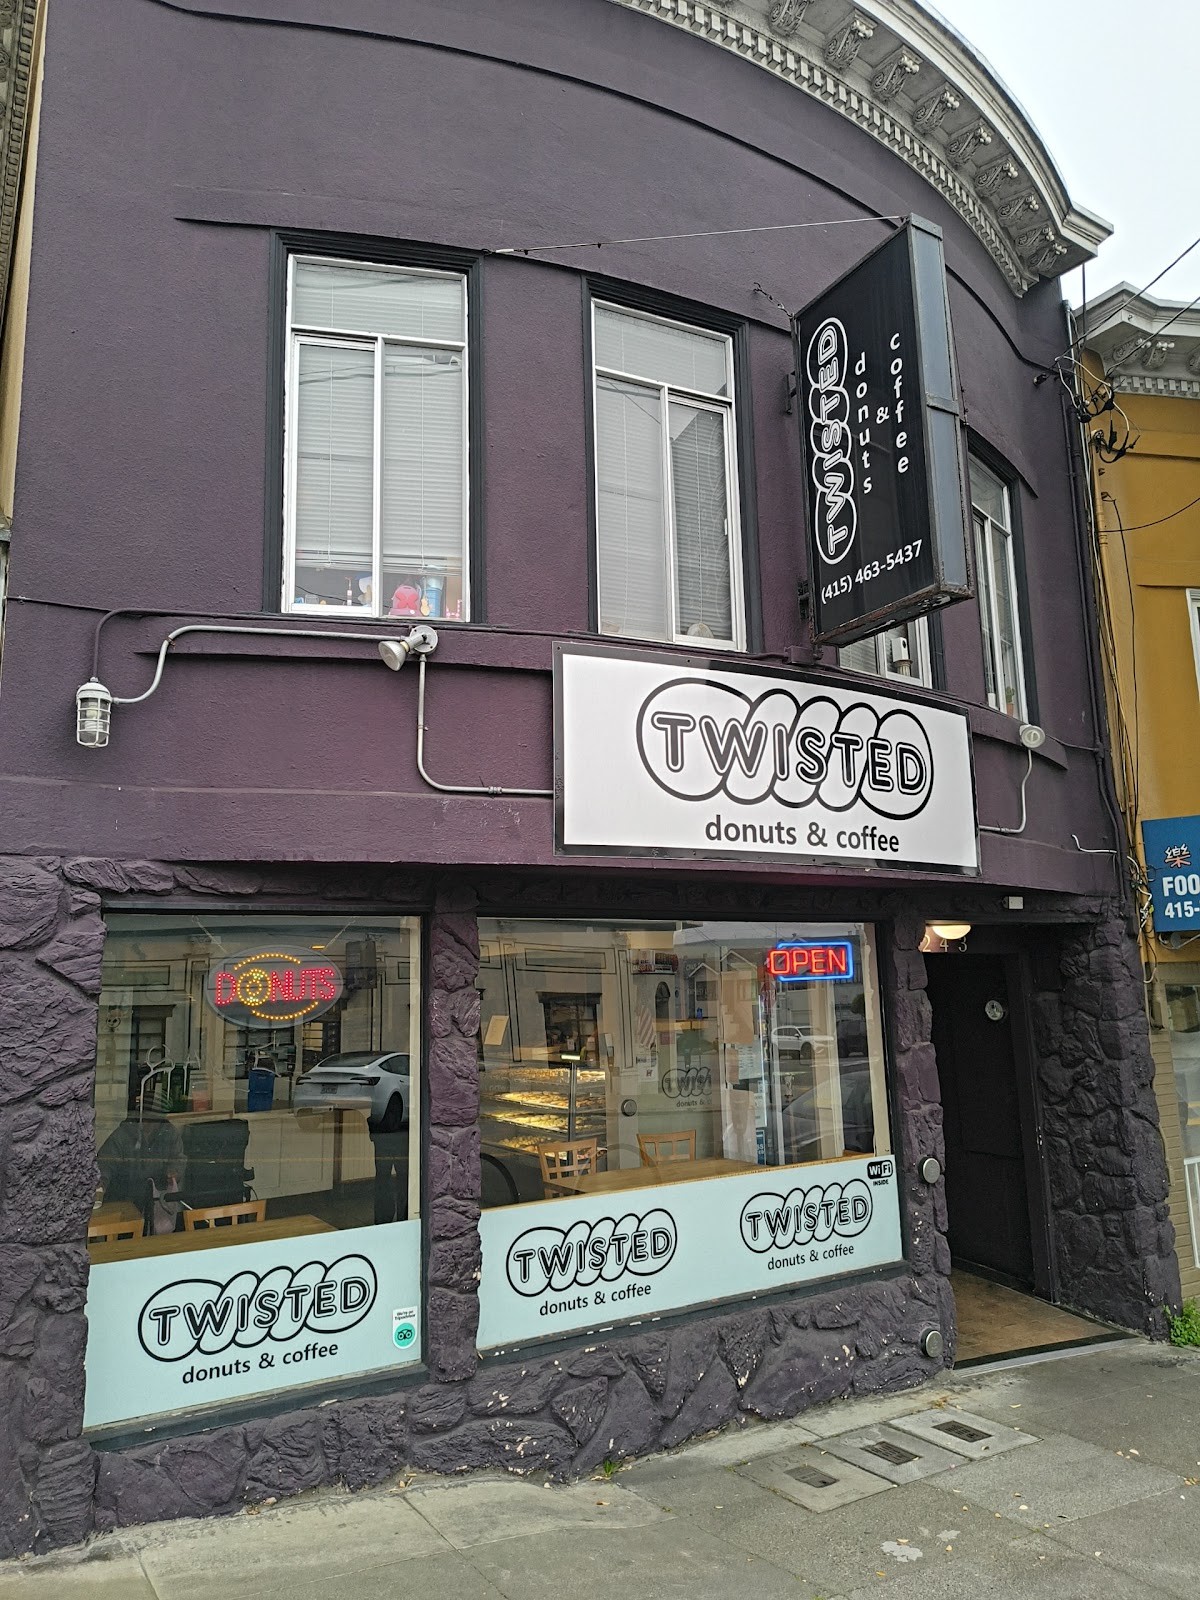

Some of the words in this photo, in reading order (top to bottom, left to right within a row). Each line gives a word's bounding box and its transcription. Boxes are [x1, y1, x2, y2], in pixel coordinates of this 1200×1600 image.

[854, 351, 873, 495] donuts
[876, 405, 890, 424] &
[889, 332, 909, 474] coffee
[817, 324, 848, 556] TWISTED
[821, 574, 853, 605] (415)
[854, 539, 923, 585] 463-5437
[650, 711, 928, 796] TWISTED
[705, 814, 797, 846] donuts
[806, 821, 828, 847] &
[836, 825, 900, 852] coffee
[1162, 874, 1200, 897] FOO
[1164, 901, 1200, 919] 415-
[769, 948, 847, 975] OPEN
[922, 934, 968, 953] 243
[214, 967, 336, 1007] DONUTS
[868, 1163, 891, 1175] WiFi
[746, 1195, 869, 1241] TWISTED
[512, 1227, 673, 1284] TWISTED
[768, 1253, 806, 1271] donuts
[809, 1251, 819, 1262] &
[822, 1245, 855, 1261] coffee
[149, 1276, 370, 1346] TWISTED
[539, 1295, 588, 1317] donuts
[594, 1291, 606, 1306] &
[611, 1283, 652, 1303] coffee
[182, 1359, 251, 1384] donuts
[258, 1352, 275, 1369] &
[282, 1343, 339, 1365] coffee
